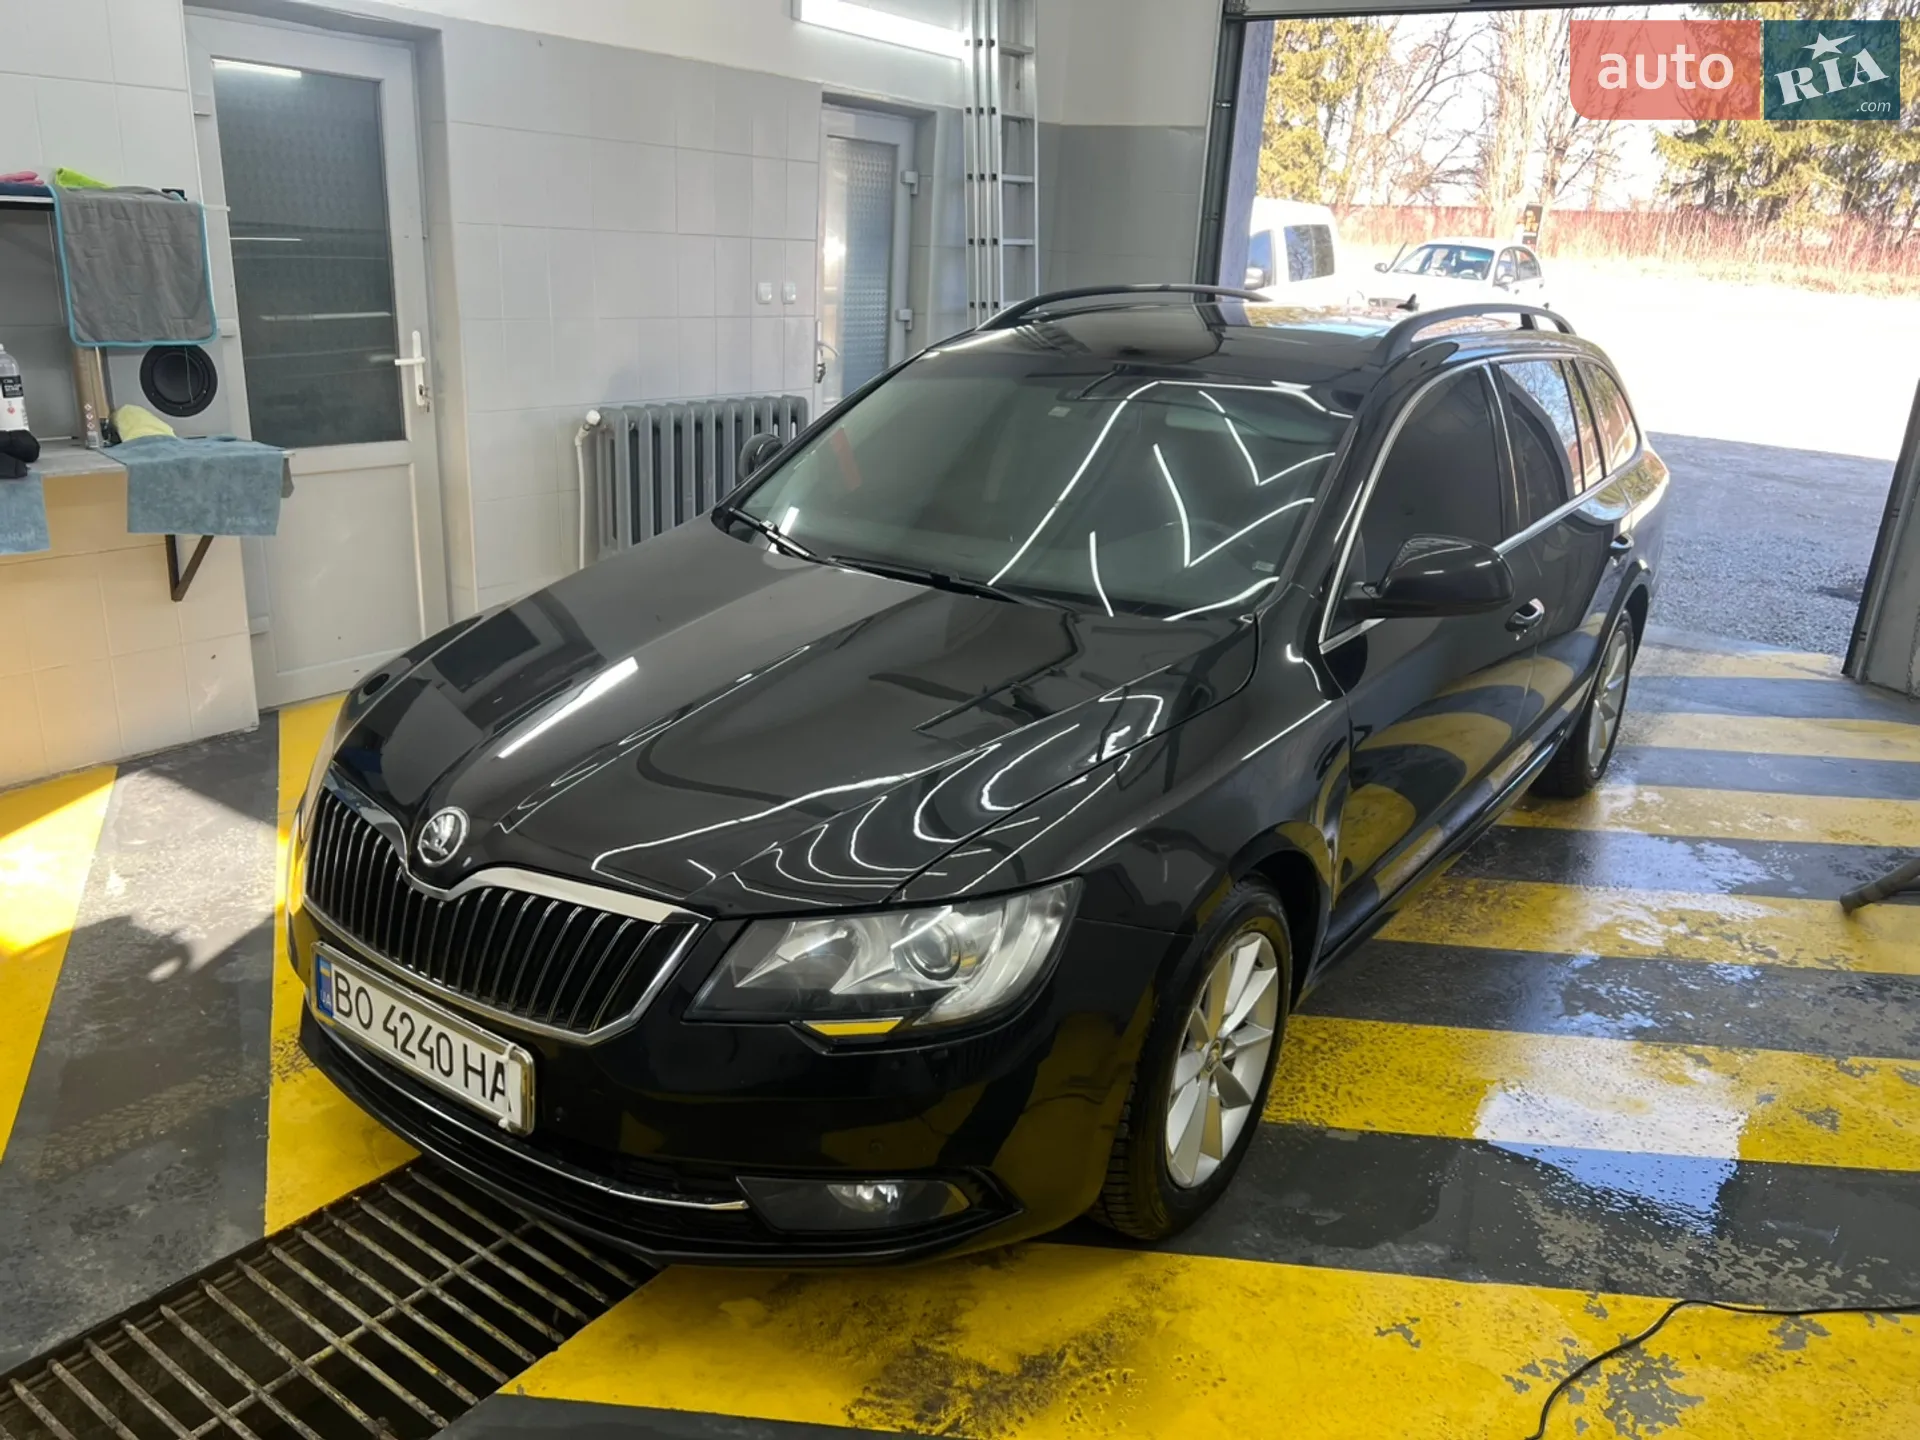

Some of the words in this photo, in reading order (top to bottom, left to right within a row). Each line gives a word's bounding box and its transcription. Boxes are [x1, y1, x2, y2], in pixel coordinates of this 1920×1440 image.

[335, 970, 373, 1030] BO
[383, 1004, 454, 1077] 4240
[463, 1043, 512, 1112] HA
